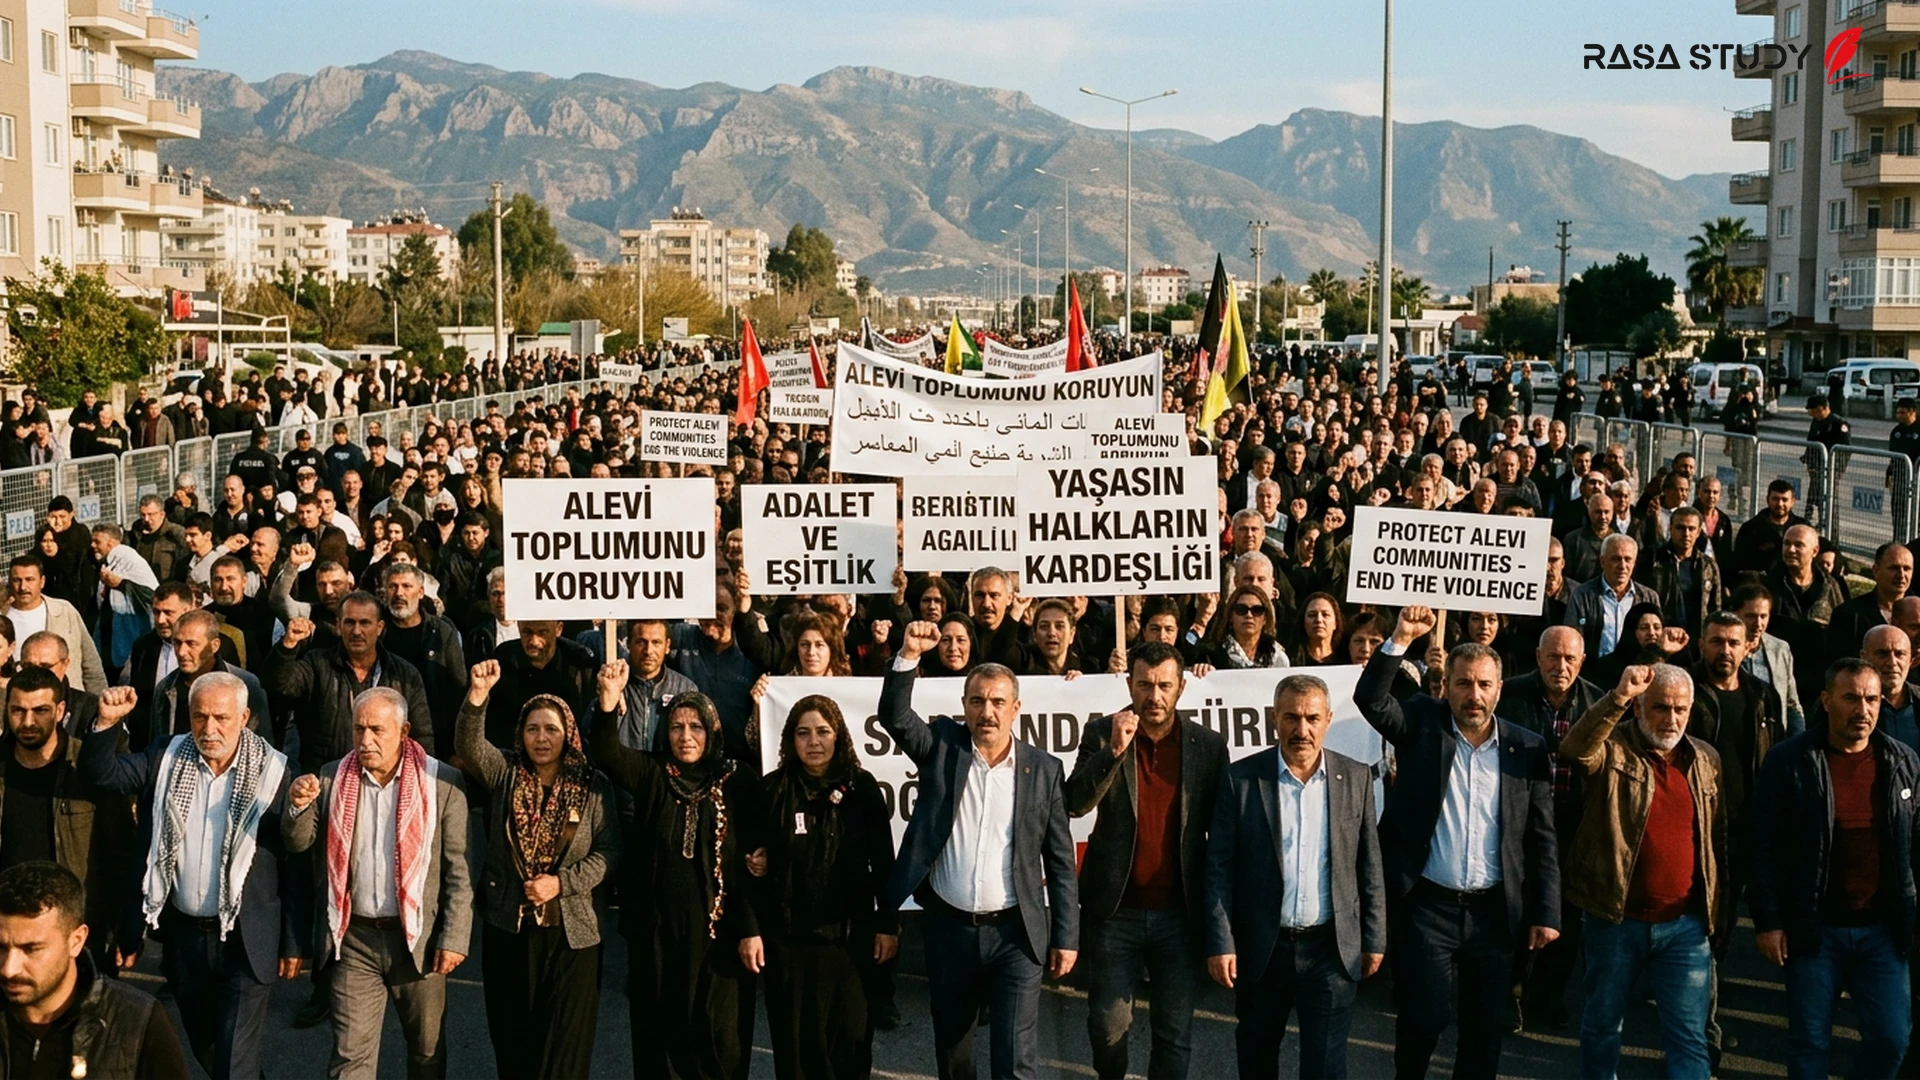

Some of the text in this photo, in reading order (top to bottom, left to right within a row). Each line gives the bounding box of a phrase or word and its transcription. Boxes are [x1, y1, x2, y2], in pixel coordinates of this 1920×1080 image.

[845, 362, 1154, 401] ALEVİ TOPLUMUNU KORUYUN
[649, 416, 691, 429] PROTECT
[1114, 415, 1155, 431] ALEVİ
[663, 445, 680, 456] THE
[682, 446, 725, 459] VIOLENCE
[1091, 433, 1179, 448] TOPLUMUNU
[1048, 466, 1184, 506] YAŞASIN
[563, 484, 652, 520] ALEVİ
[762, 491, 875, 518] ADALET
[801, 525, 838, 551] VE
[1029, 509, 1208, 542] HALKLARIN
[1377, 521, 1526, 549] PROTECT ALEVI
[510, 530, 706, 561] TOPLUMUNU
[1373, 546, 1512, 573] COMMUNITIES
[766, 553, 877, 591] EŞİTLİK
[1025, 543, 1212, 590] KARDEŞLİĞİ
[534, 571, 684, 601] KORUYUN
[1356, 570, 1538, 601] END THE VIOLENCE
